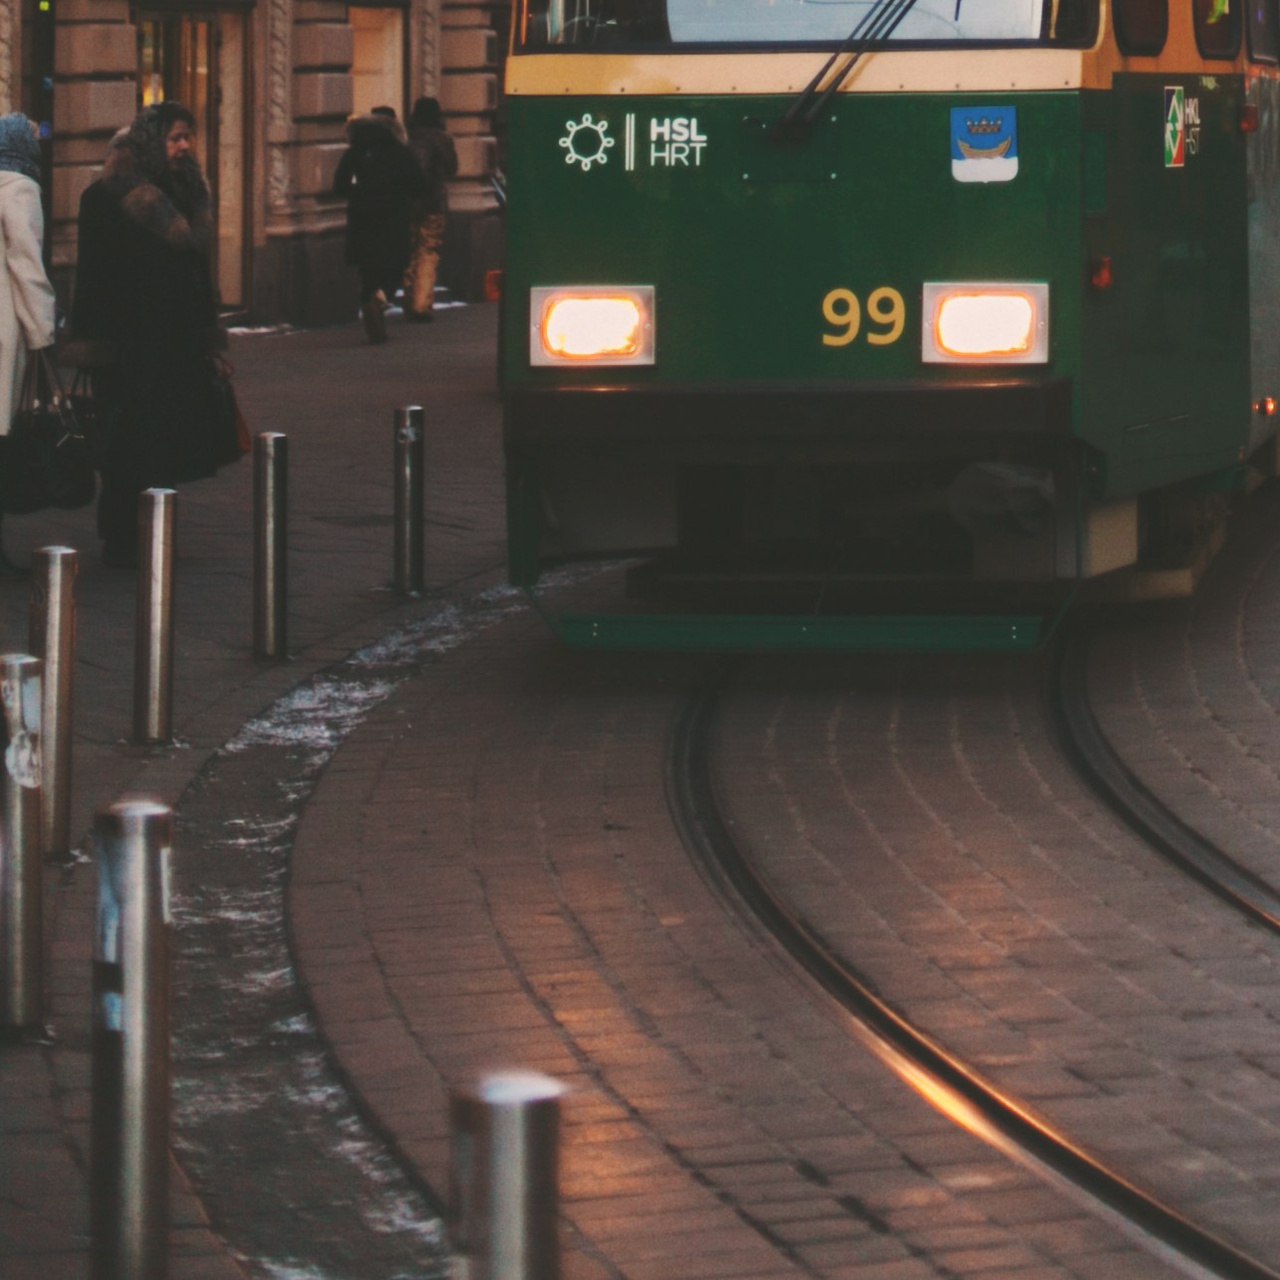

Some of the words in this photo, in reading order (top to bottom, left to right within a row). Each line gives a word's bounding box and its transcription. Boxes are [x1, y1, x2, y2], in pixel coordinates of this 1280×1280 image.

[1184, 98, 1200, 124] HKL
[650, 117, 708, 142] HSL
[650, 143, 708, 166] HRT
[822, 286, 906, 347] 99
